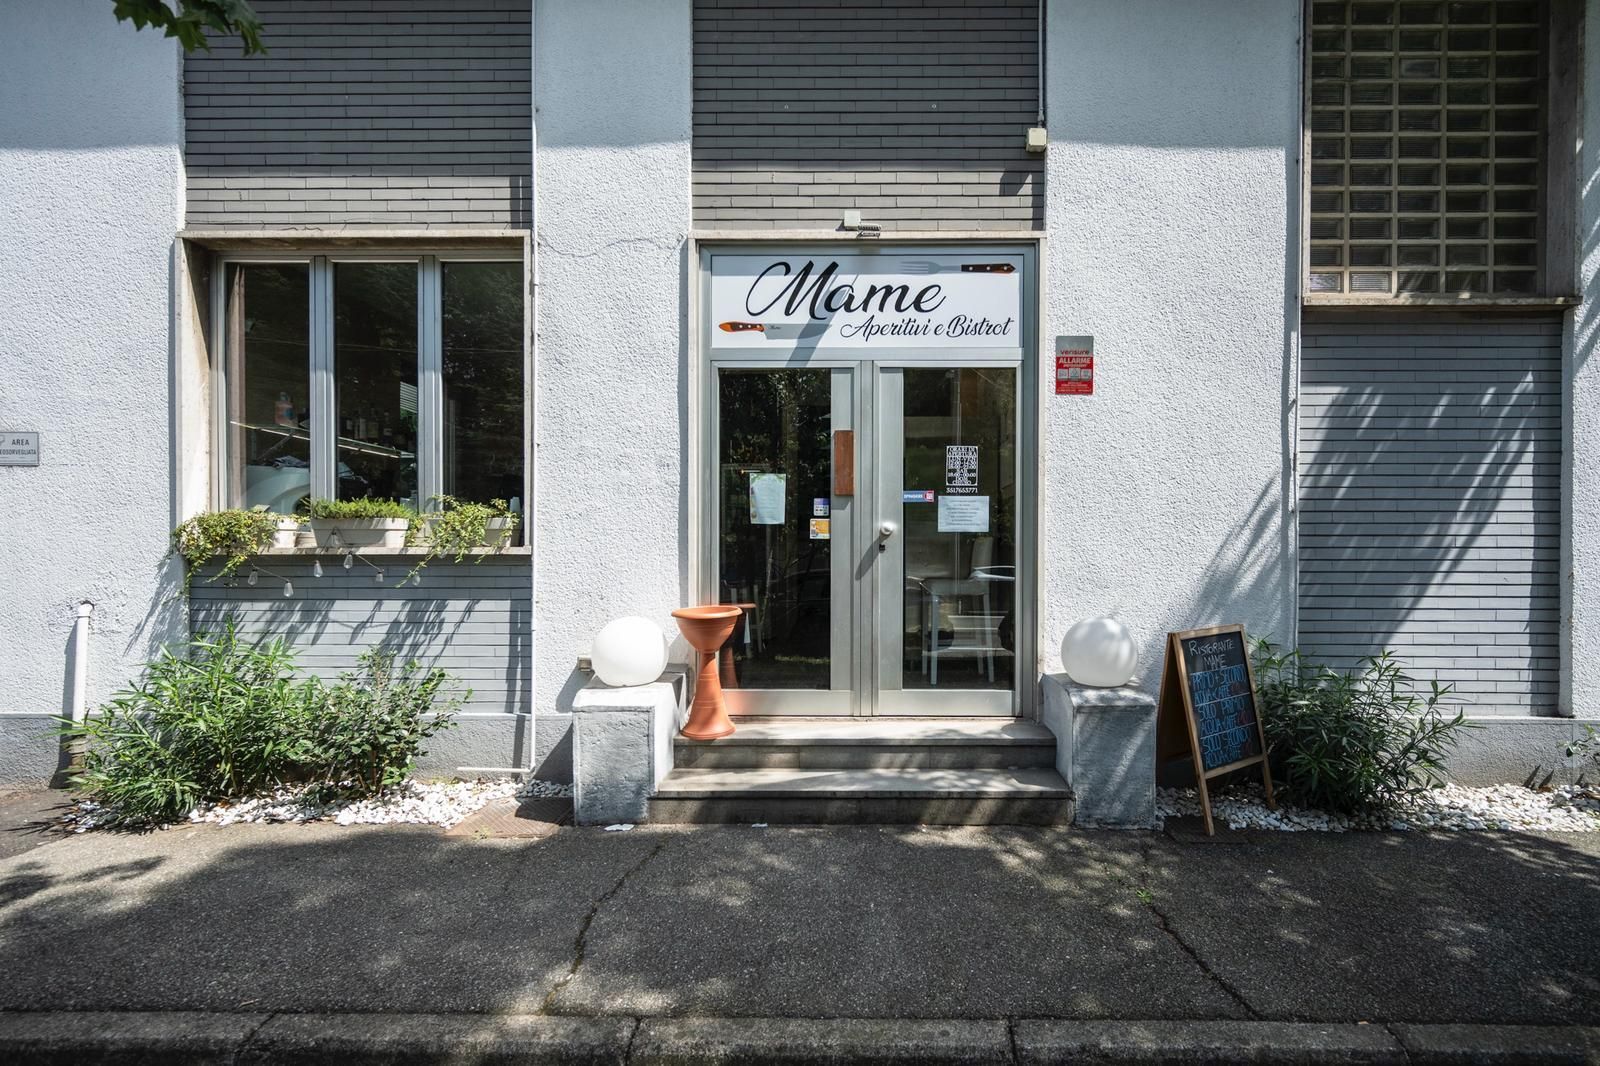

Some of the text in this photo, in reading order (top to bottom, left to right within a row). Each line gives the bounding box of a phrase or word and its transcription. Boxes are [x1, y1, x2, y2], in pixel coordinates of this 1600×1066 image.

[746, 260, 947, 320] Mame
[840, 314, 1014, 342] Aperitivi e Bistrot
[11, 438, 30, 446] AREA
